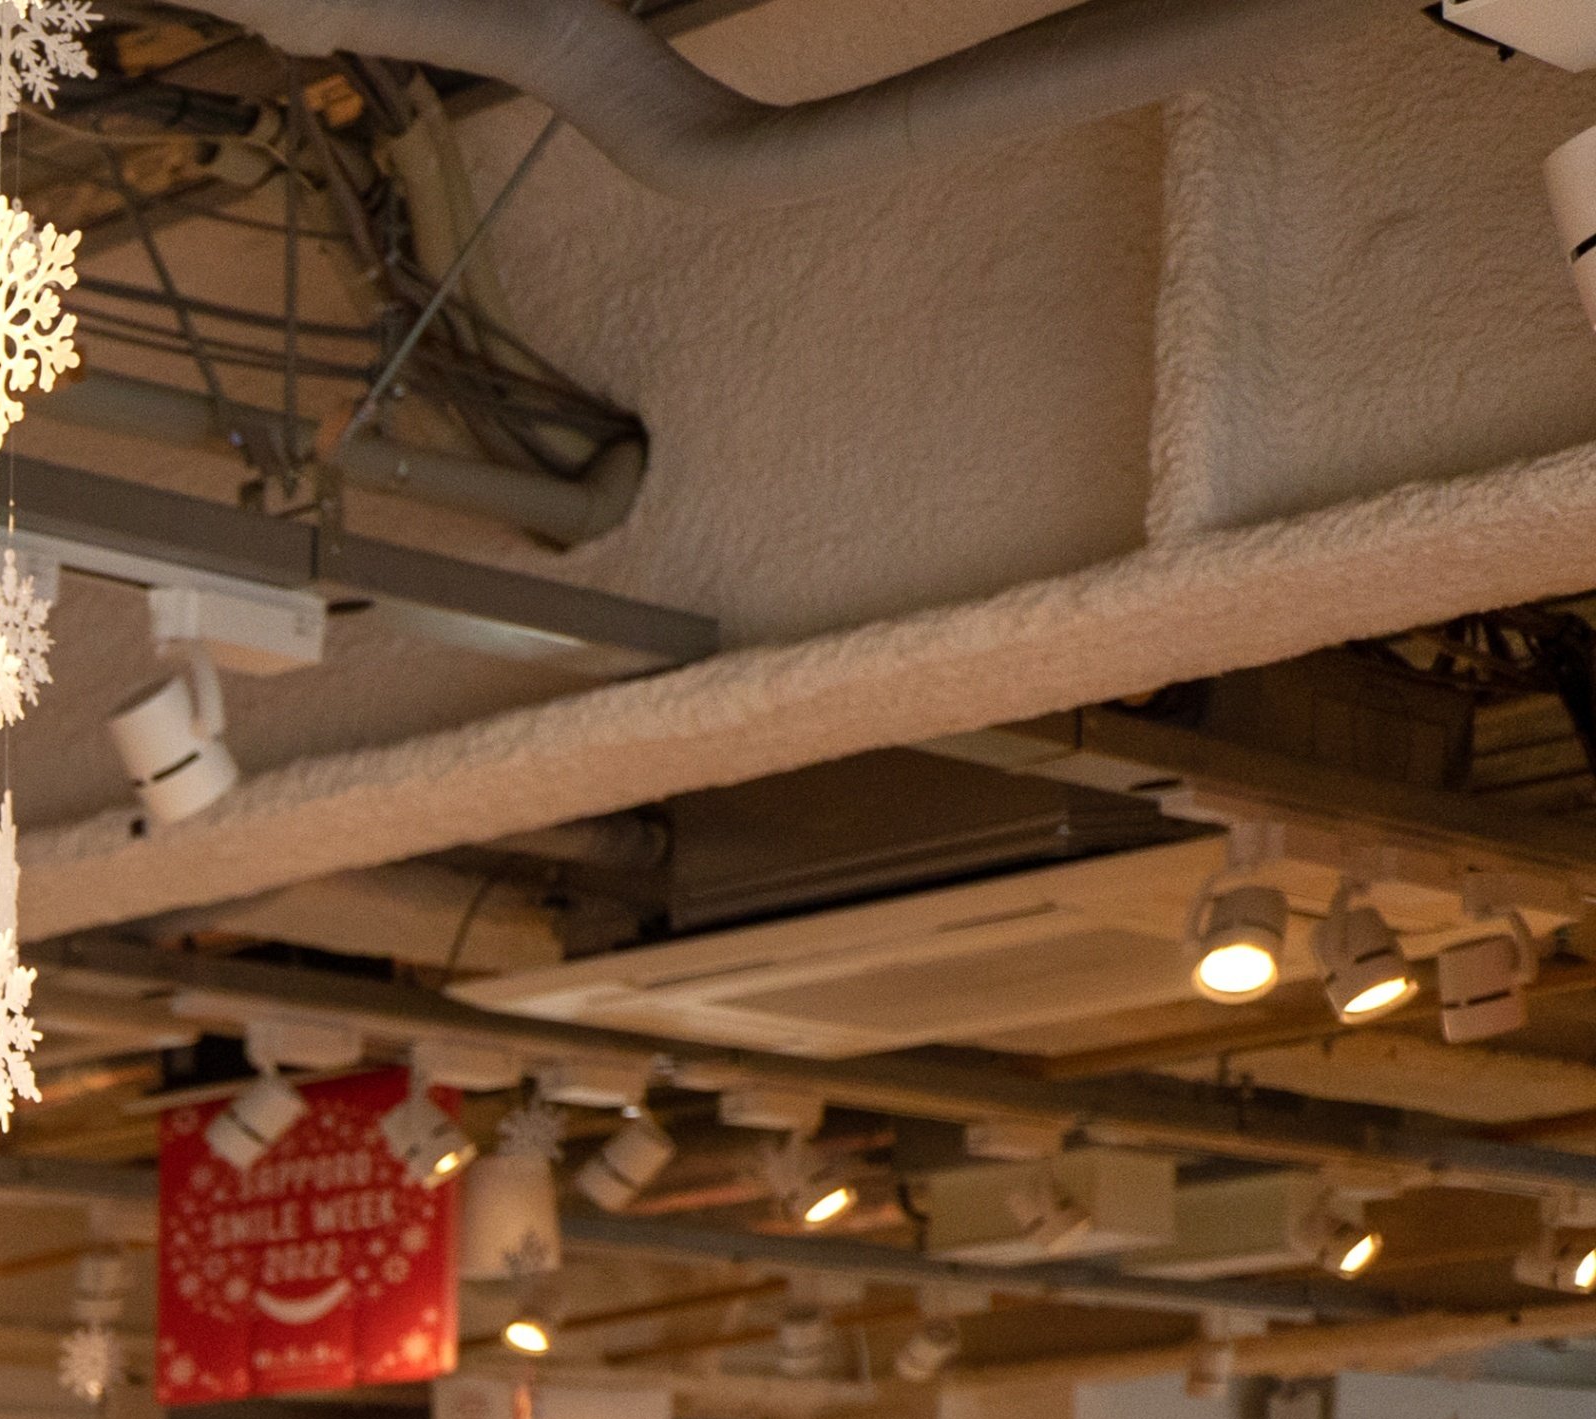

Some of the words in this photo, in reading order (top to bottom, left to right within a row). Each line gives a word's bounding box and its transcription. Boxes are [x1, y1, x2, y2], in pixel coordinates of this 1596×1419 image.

[210, 1205, 303, 1247] SMILE
[311, 1193, 398, 1233] WEEK
[261, 1239, 344, 1281] 2022
